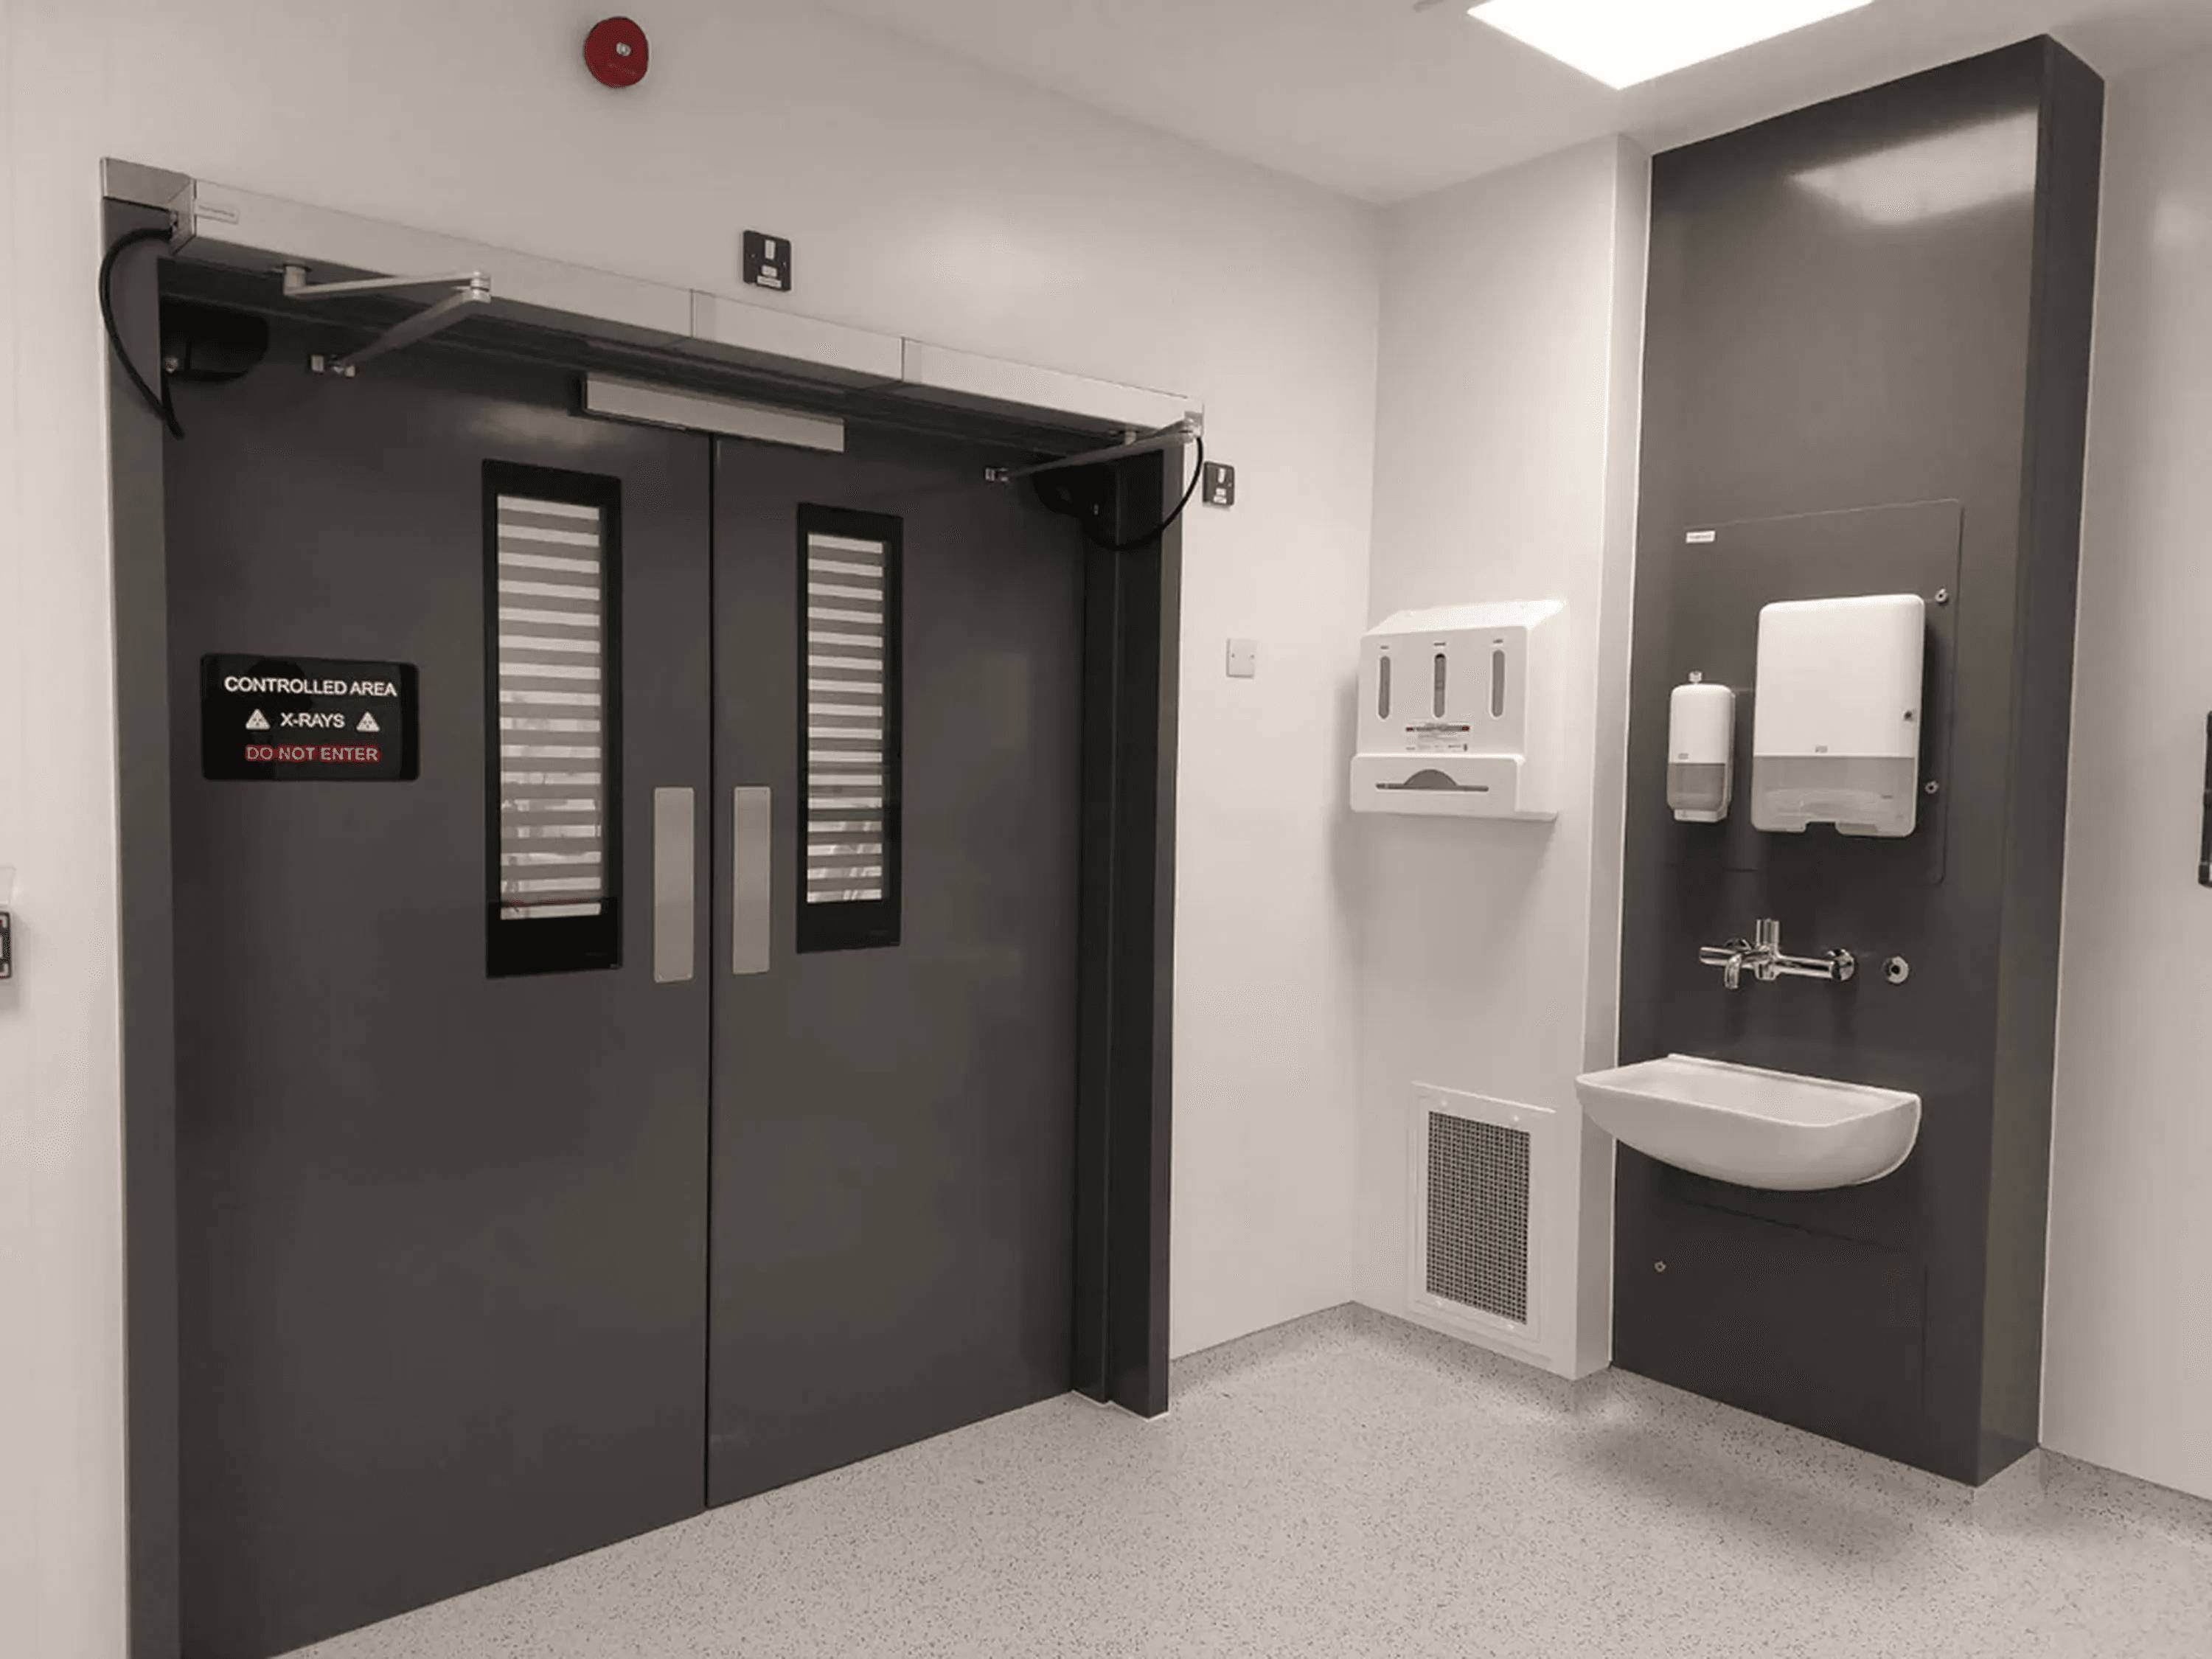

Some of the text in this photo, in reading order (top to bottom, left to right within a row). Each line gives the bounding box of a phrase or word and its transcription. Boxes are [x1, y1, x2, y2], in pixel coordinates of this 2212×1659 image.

[224, 676, 397, 697] CONTROLLED AREA
[280, 712, 345, 728] X-RAYS
[246, 747, 378, 761] DO NOT ENTER
